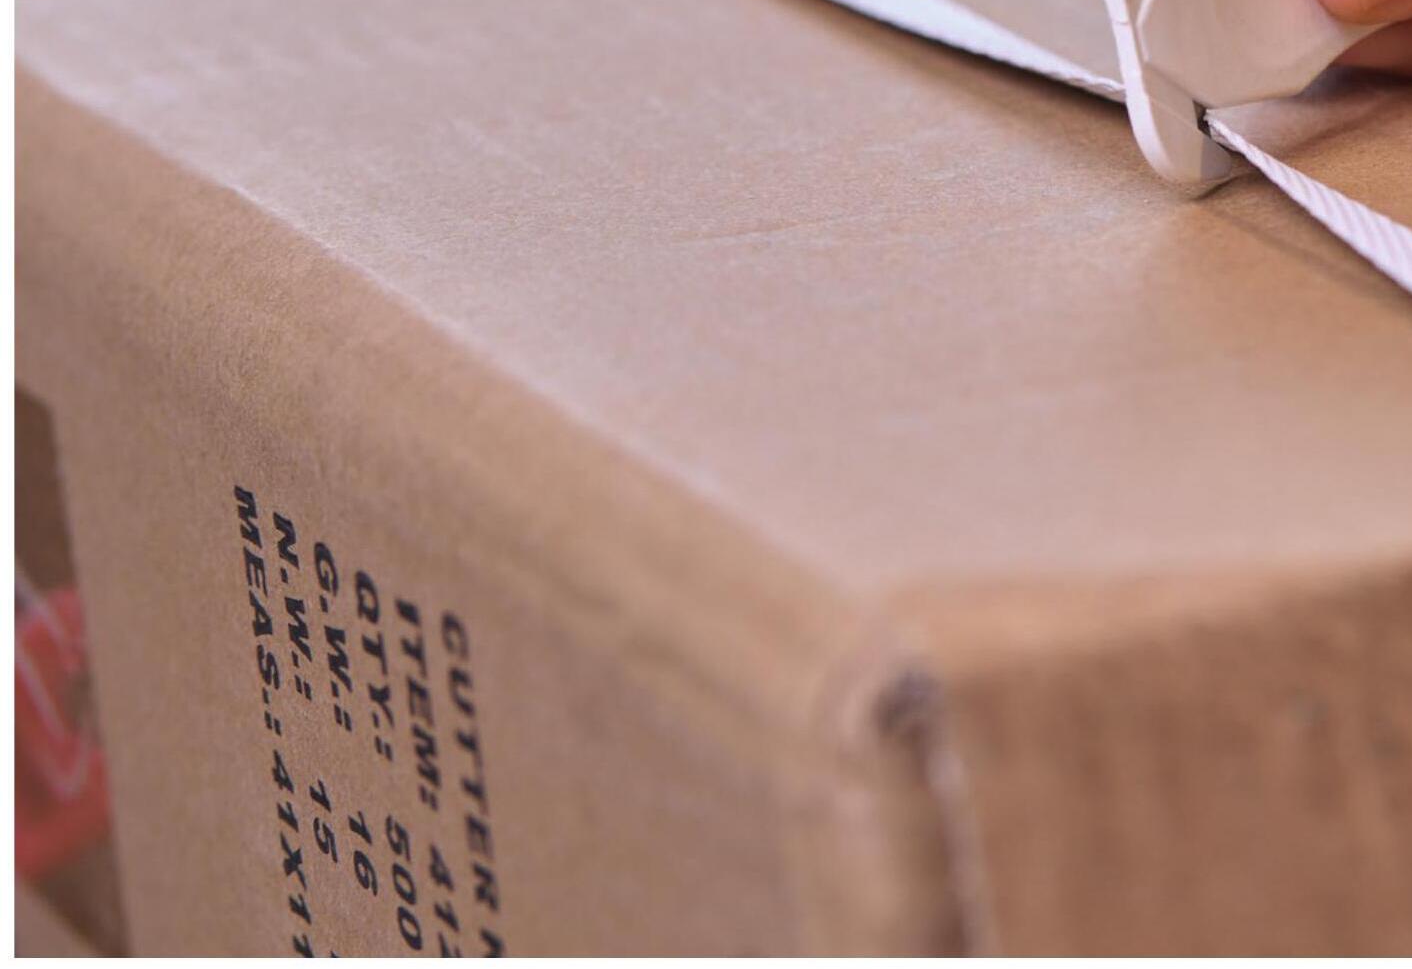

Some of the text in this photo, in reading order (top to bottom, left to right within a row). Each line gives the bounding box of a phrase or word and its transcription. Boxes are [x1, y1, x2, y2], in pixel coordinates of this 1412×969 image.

[273, 511, 338, 864] N.W.: 15
[314, 541, 379, 898] G.W.: 16
[355, 569, 422, 951] QTY.: 500
[395, 597, 442, 811] ITEM:
[442, 608, 500, 912] CUTTER
